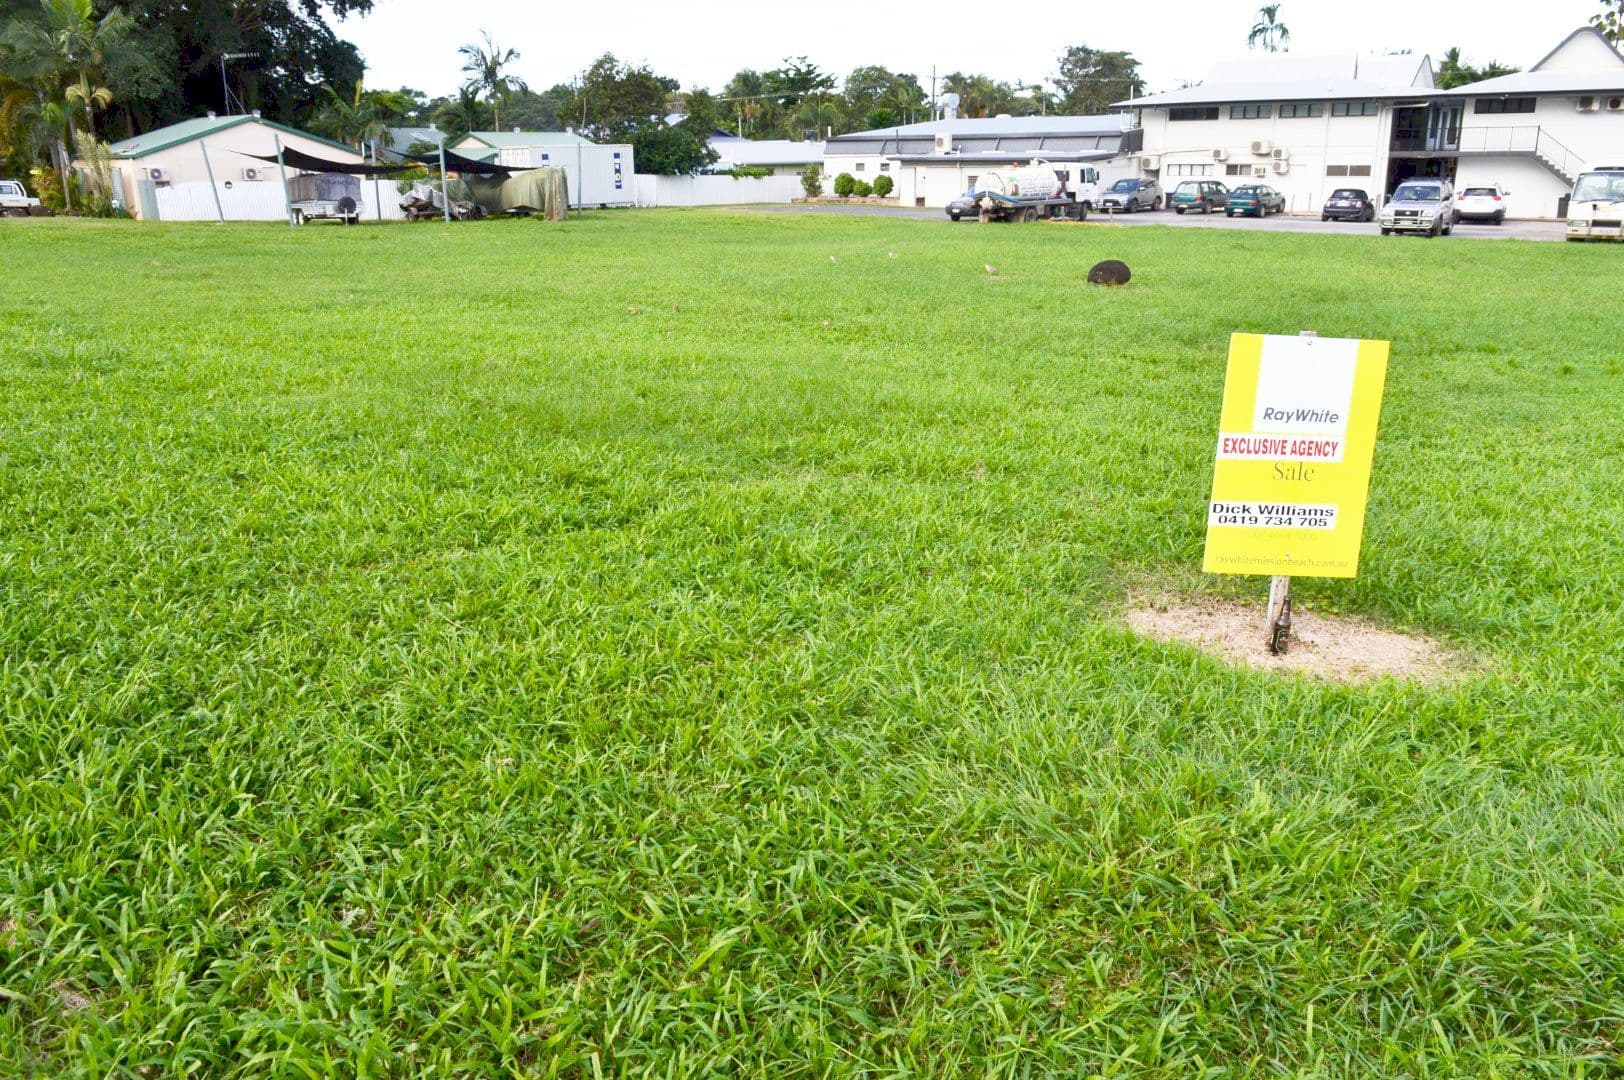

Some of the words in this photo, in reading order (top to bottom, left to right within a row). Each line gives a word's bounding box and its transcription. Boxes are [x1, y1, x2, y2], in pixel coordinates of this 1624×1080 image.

[1223, 438, 1288, 455] EXCLUSIVE
[1289, 440, 1339, 457] AGENCY
[1272, 461, 1315, 481] Sale
[1212, 503, 1252, 514] Dick
[1258, 504, 1334, 517] Williams
[1218, 515, 1258, 525] 0419
[1264, 516, 1292, 526] 734
[1299, 517, 1327, 527] 705
